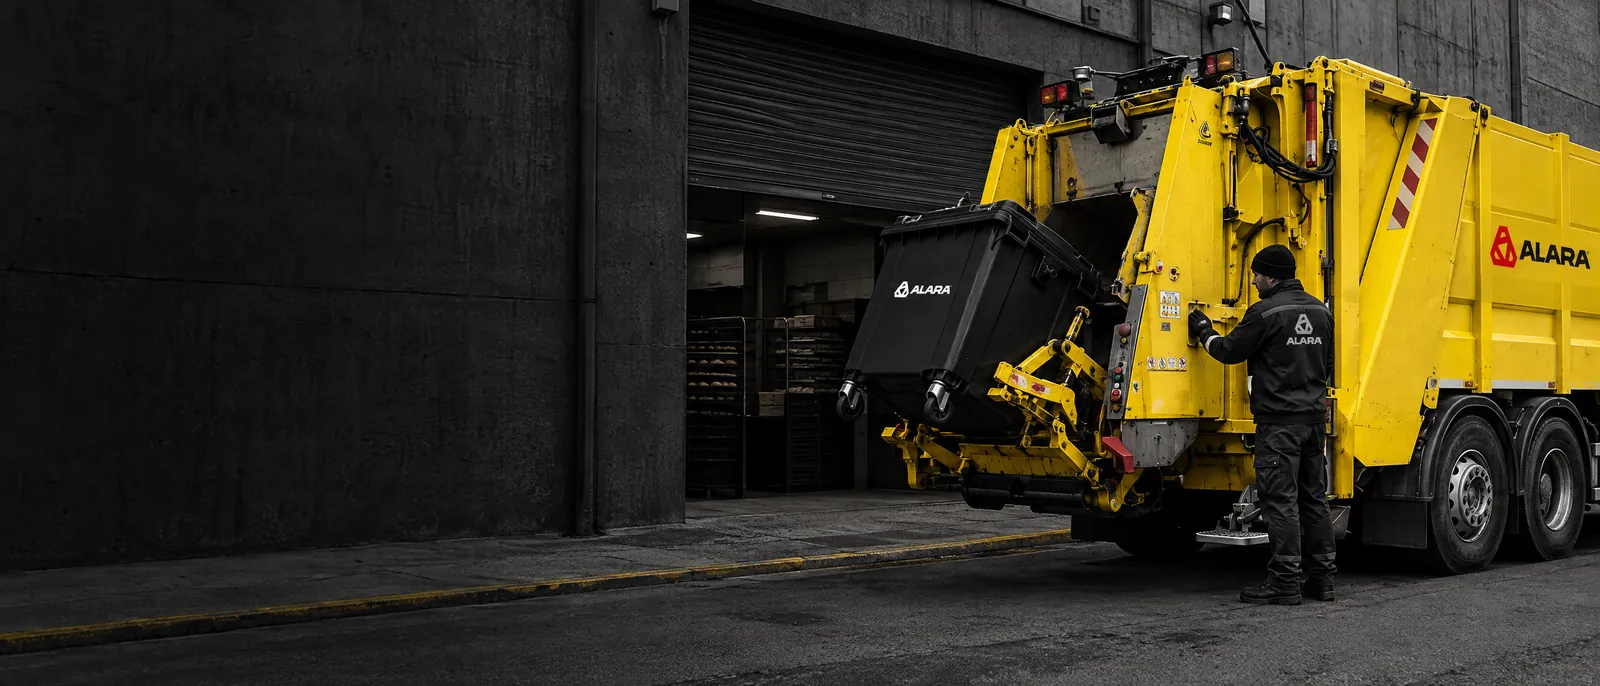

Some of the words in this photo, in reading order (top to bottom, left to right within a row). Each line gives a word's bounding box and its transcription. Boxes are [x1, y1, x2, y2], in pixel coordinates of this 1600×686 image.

[1519, 240, 1591, 269] ALARA
[910, 284, 951, 295] ALARA
[1286, 336, 1322, 345] ALARA
